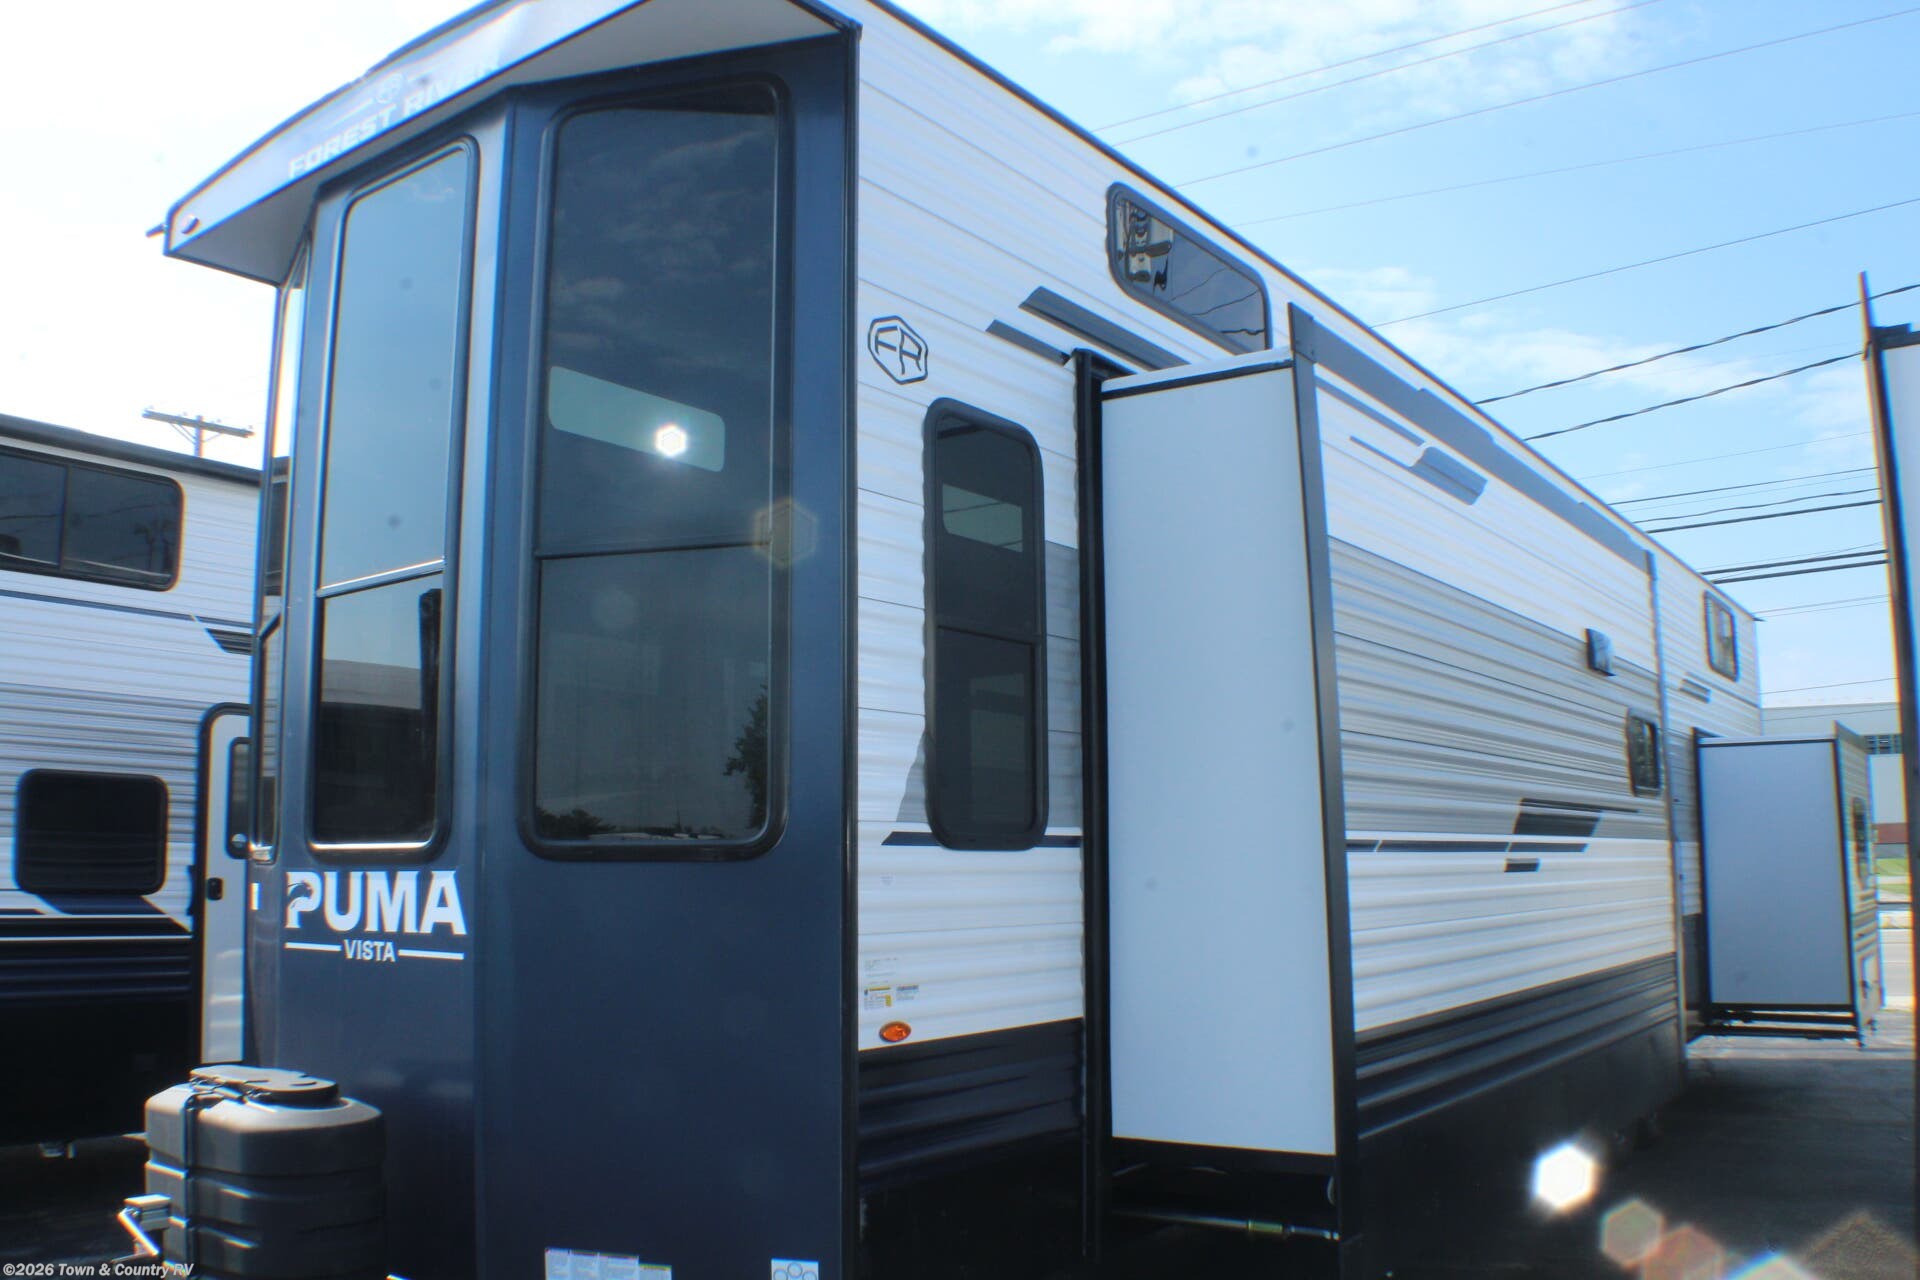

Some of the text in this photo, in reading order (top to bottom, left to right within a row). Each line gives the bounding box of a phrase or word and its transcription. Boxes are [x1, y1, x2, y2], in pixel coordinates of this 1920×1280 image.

[289, 103, 397, 179] FOREST
[284, 870, 467, 935] PUMA
[343, 938, 396, 962] VISTA
